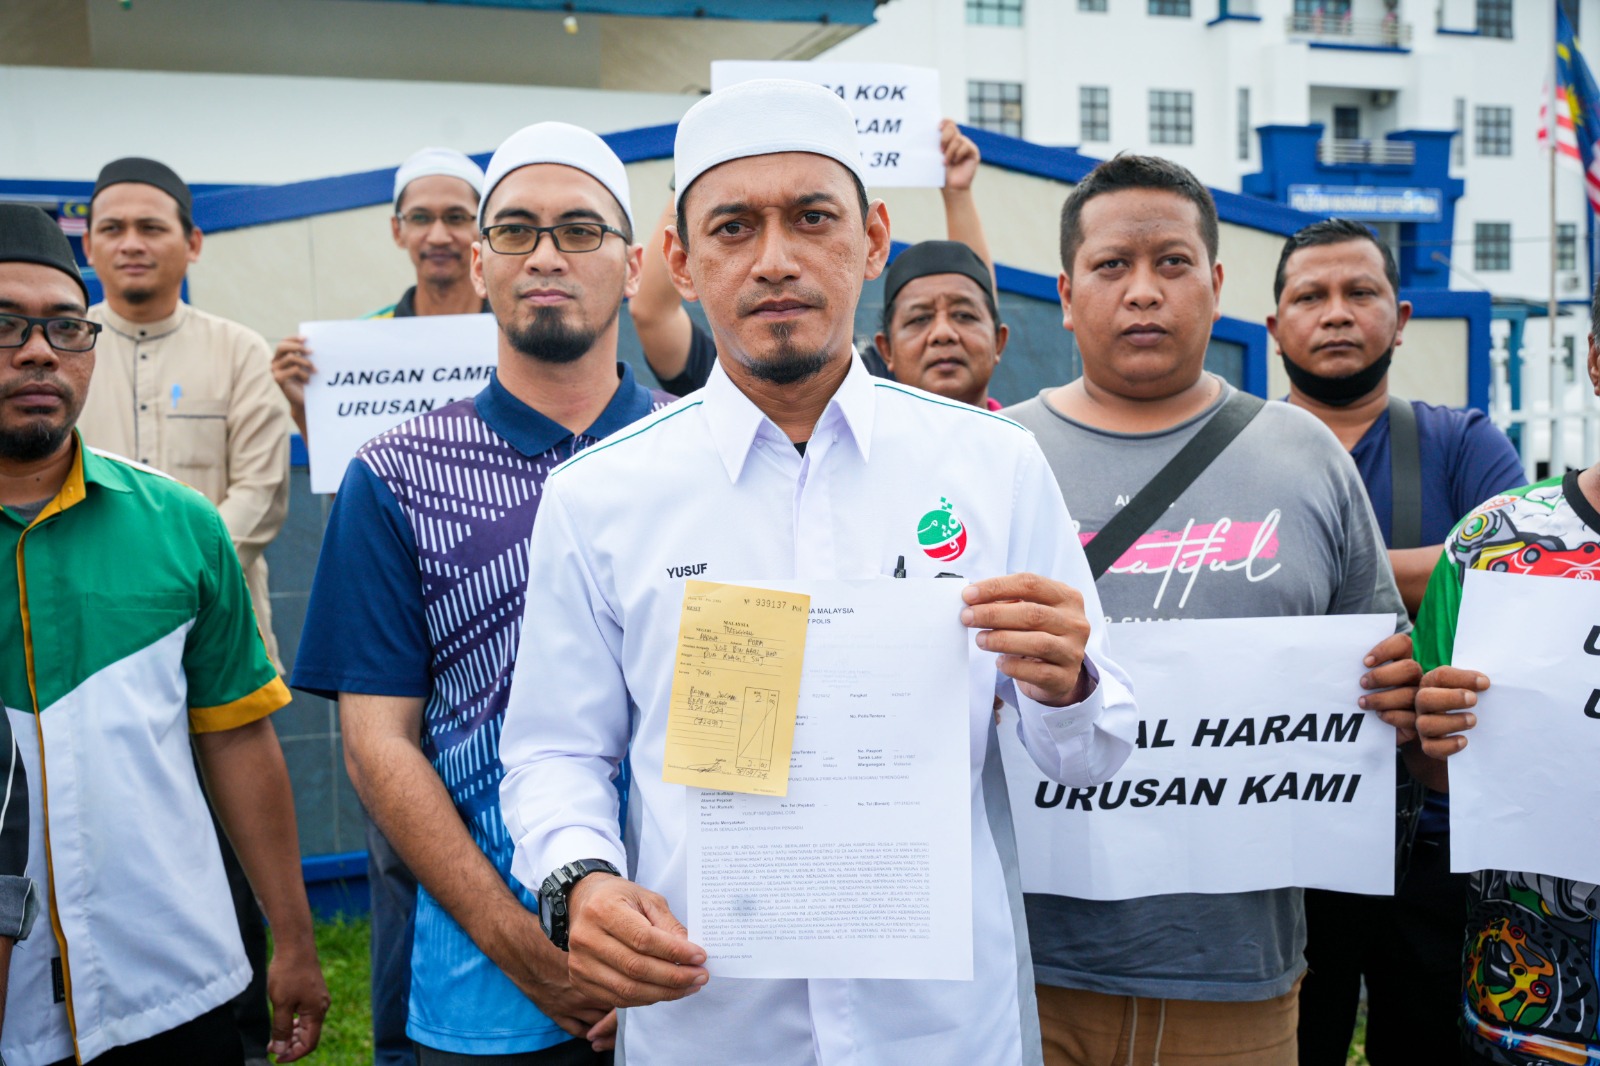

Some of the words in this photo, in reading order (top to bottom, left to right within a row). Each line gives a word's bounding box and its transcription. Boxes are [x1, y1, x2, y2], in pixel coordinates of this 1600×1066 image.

[855, 85, 907, 100] KOK
[870, 152, 900, 167] 3R
[327, 369, 425, 386] JANGAN
[337, 398, 435, 417] URUSAN
[667, 562, 708, 579] YUSUF
[756, 598, 787, 609] 939137
[723, 620, 750, 628] MALAYSIA
[1191, 713, 1364, 747] HARAM
[1034, 776, 1227, 811] URUSAN
[1238, 771, 1362, 805] KAMI
